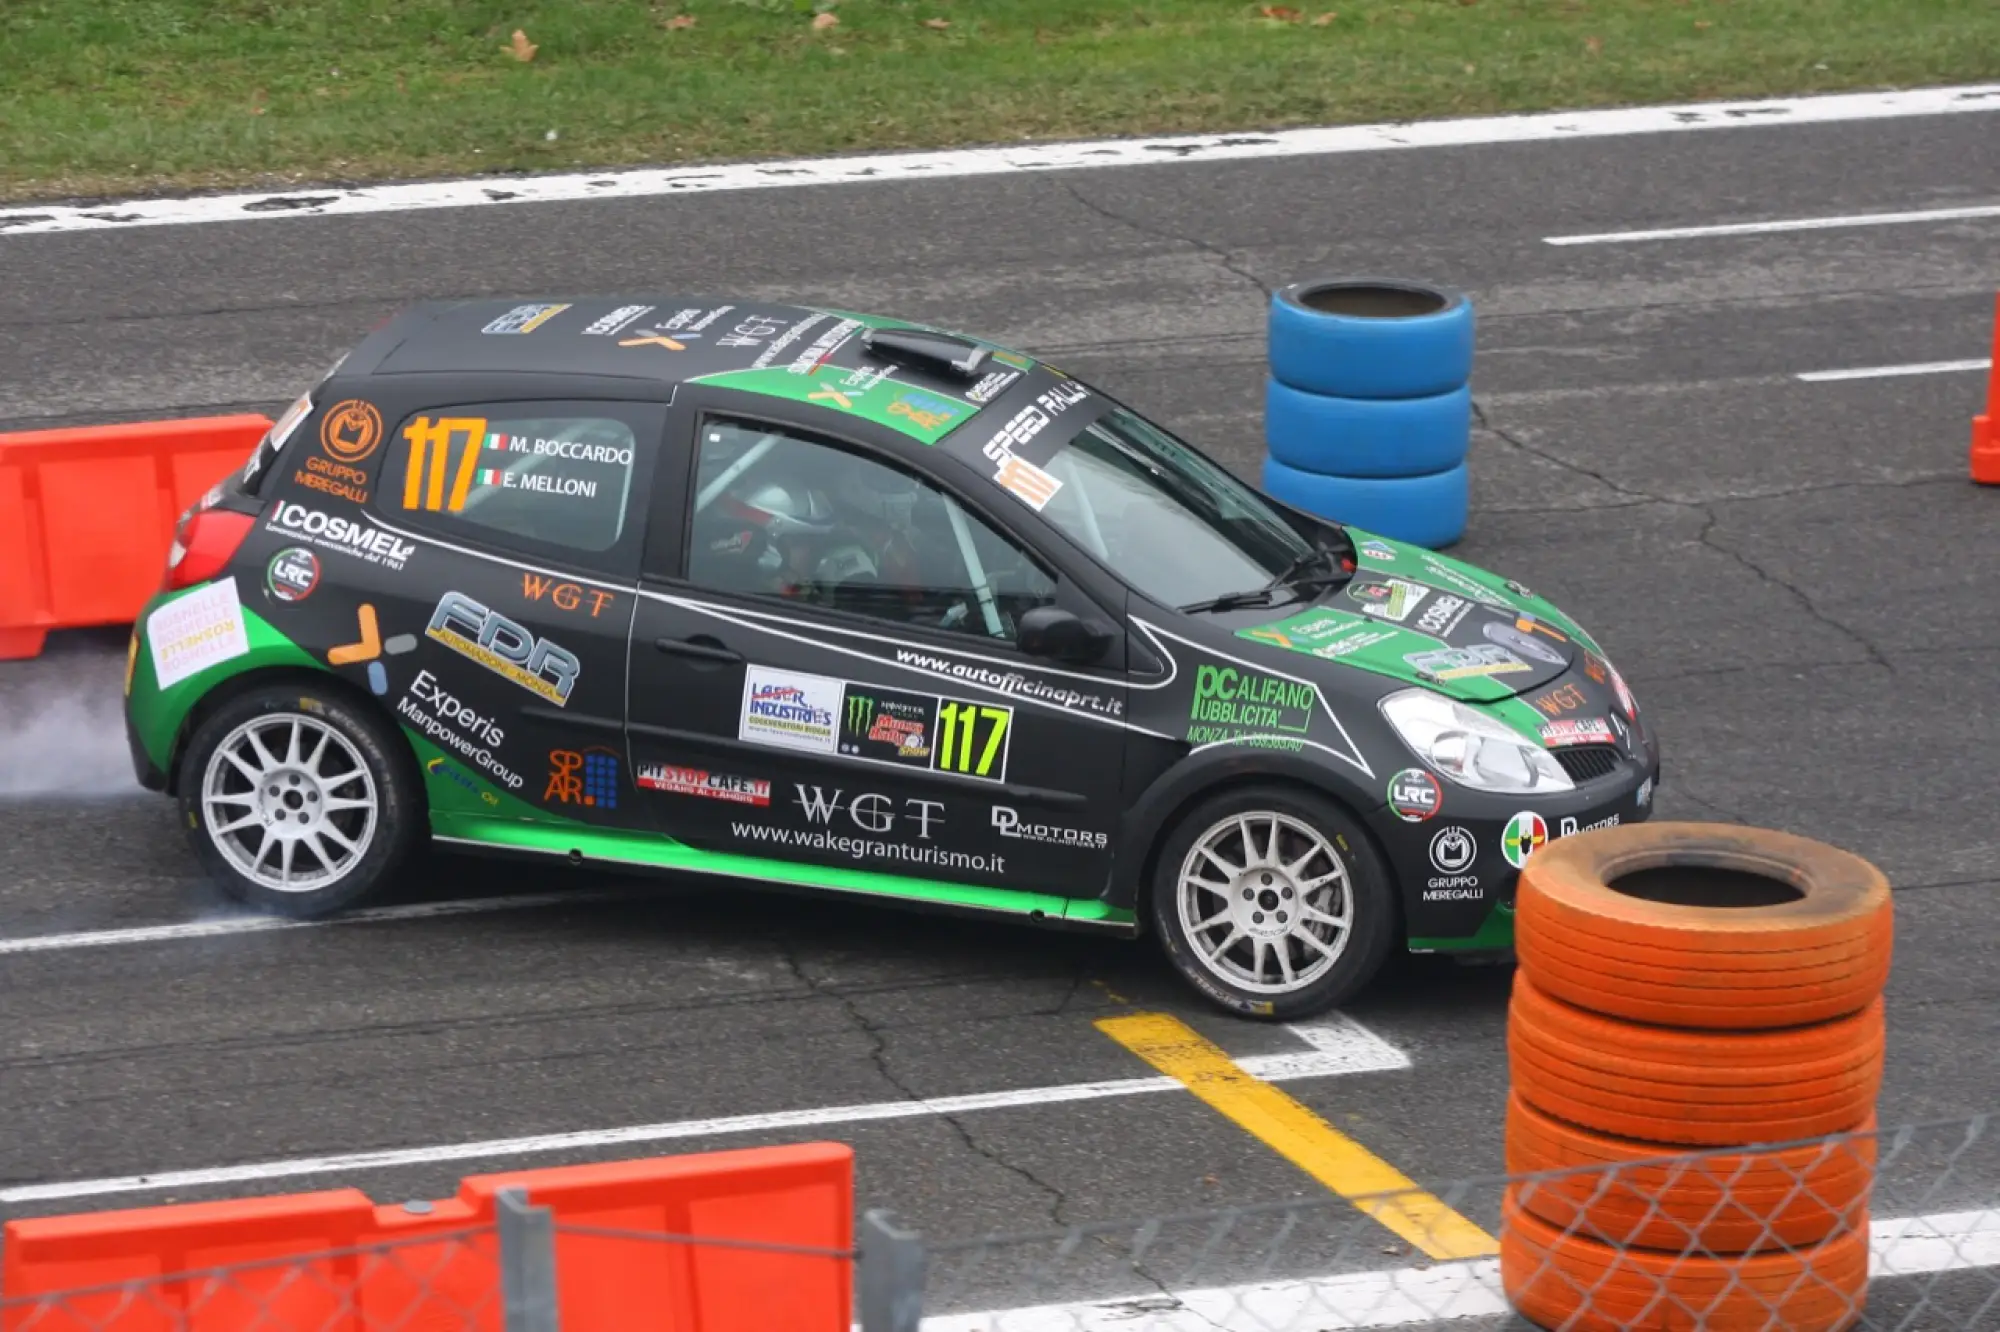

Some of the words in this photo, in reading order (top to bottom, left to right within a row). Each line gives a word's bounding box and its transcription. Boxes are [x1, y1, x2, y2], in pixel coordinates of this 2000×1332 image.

[402, 416, 488, 512] 117
[509, 435, 531, 452] M.
[534, 438, 633, 465] BOCCARDO
[305, 456, 367, 485] GRUPPO
[503, 471, 517, 488] E.
[520, 474, 598, 498] MELLONI
[274, 559, 314, 588] LRC
[522, 572, 615, 618] WGT
[896, 649, 1124, 715] www.autofficinaprt.it
[410, 669, 505, 748] Experis
[749, 699, 832, 726] INDUSTRIES
[397, 696, 524, 789] ManpowerGroup
[939, 702, 1010, 776] 117
[1393, 783, 1436, 804] LRC
[791, 783, 946, 839] WGT
[731, 821, 1005, 874] www.wakegranturismo.it
[1016, 822, 1108, 845] MOTORS
[1423, 888, 1484, 901] MEREGALLI
[1427, 876, 1479, 889] GRUPPO
